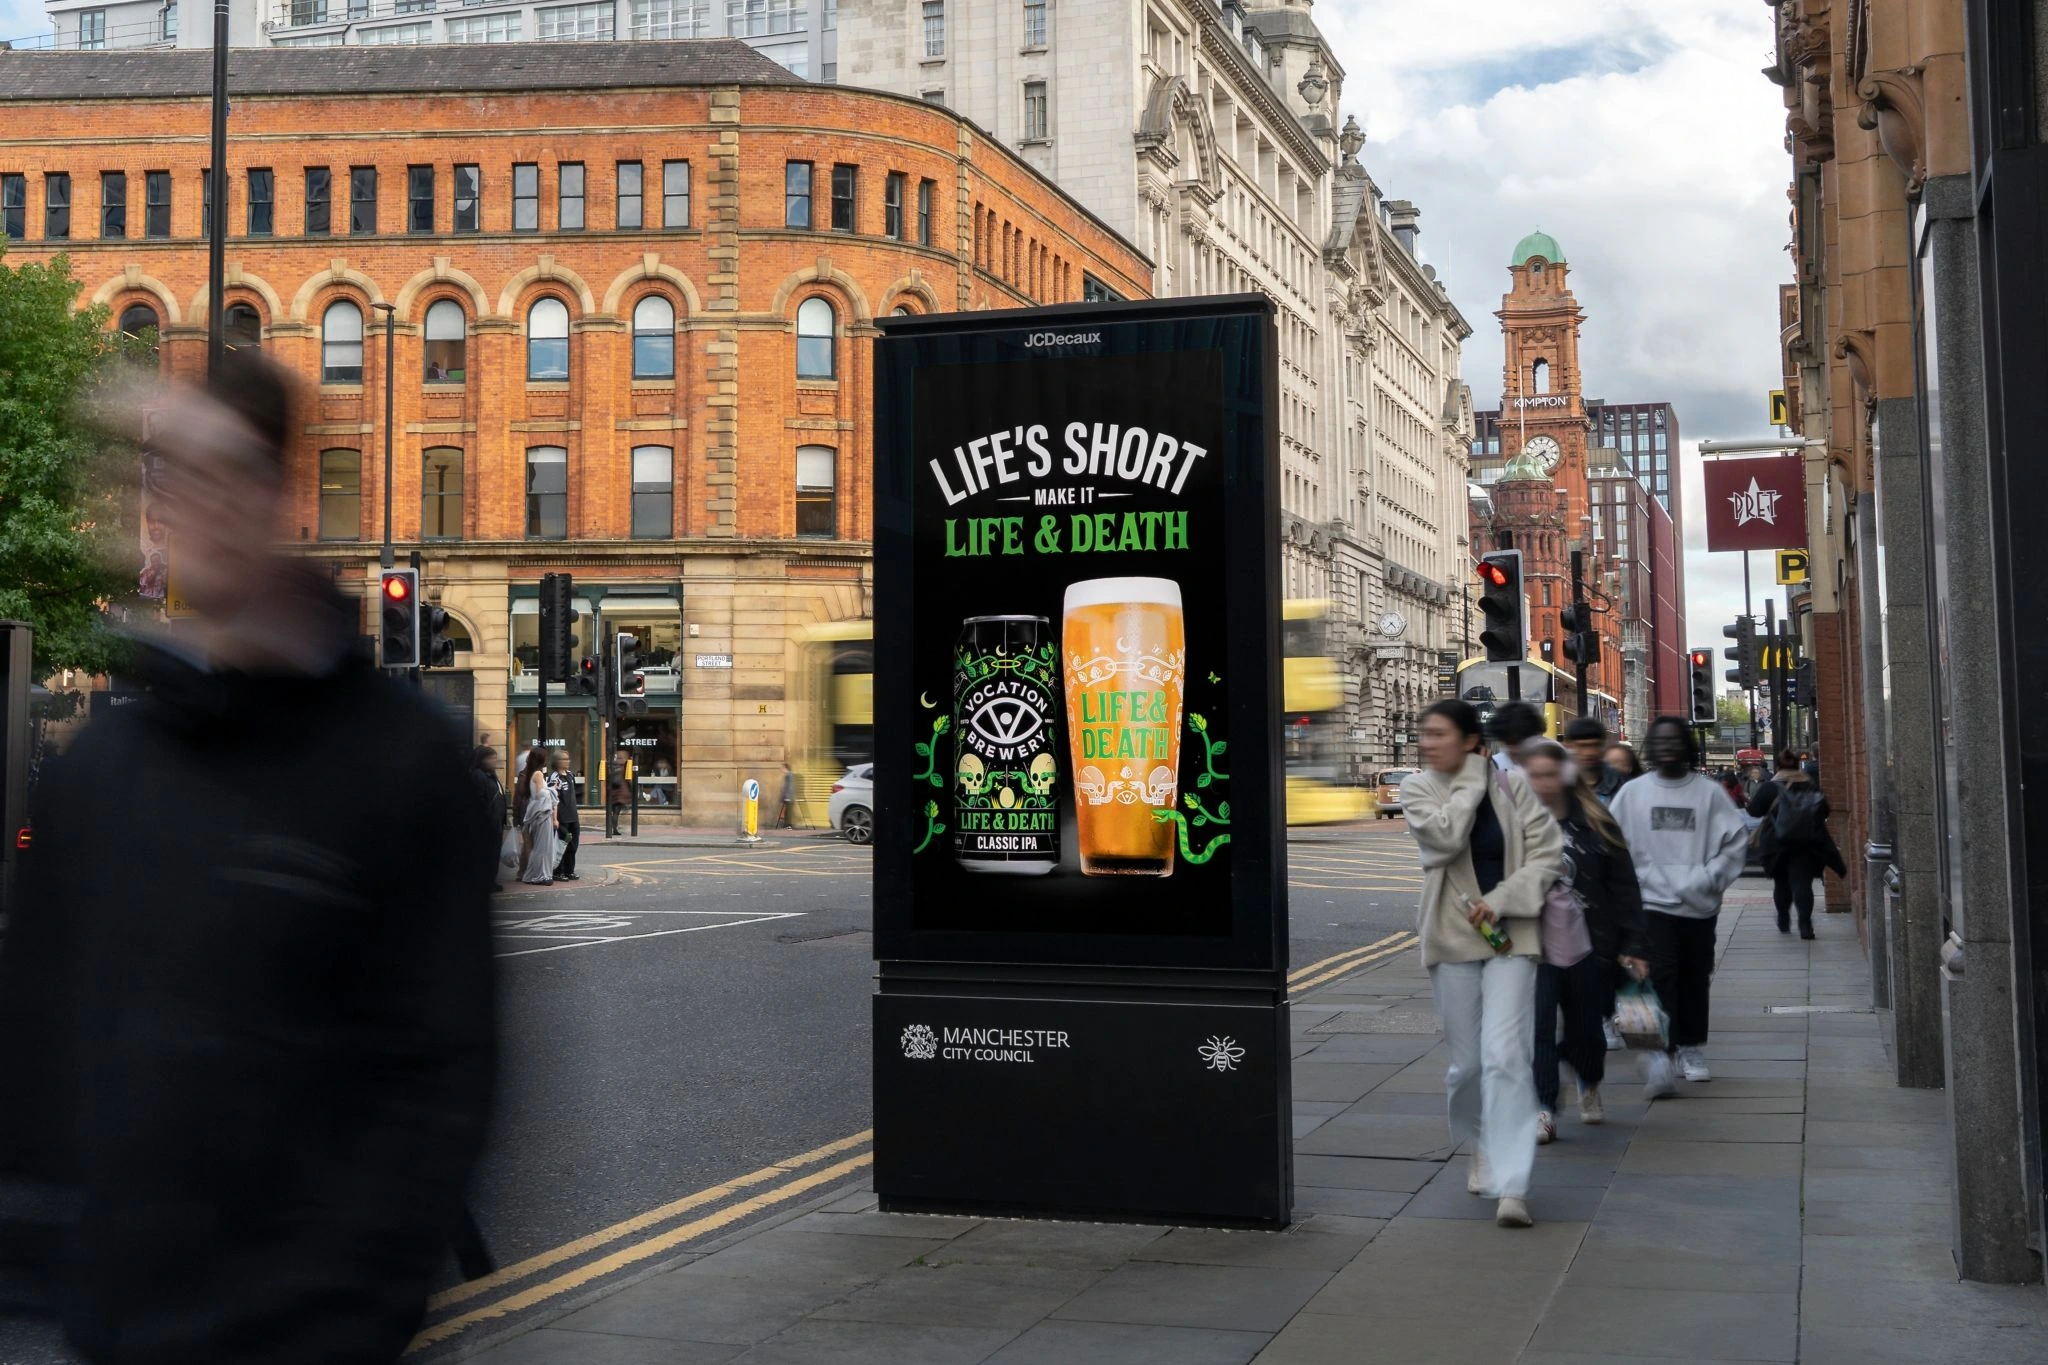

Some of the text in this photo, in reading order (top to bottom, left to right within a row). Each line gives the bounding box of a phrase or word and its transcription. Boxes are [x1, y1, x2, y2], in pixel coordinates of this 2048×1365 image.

[1024, 332, 1101, 348] JCDecaux
[1514, 396, 1566, 408] KIMPTON
[929, 421, 1207, 506] LIFE'S SHORT
[1034, 486, 1095, 506] MAKE IT
[1733, 490, 1777, 519] PRET
[944, 510, 1189, 557] LIFE & DEATH
[965, 681, 1049, 713] VOCATION
[532, 738, 658, 746] BANK STREET
[966, 729, 1046, 760] BREWERY
[1081, 727, 1169, 760] DEATH
[961, 812, 1055, 831] LIFE & DEATH
[977, 835, 1019, 850] CLASSIC
[1021, 836, 1038, 850] IPA
[943, 1027, 1071, 1048] MANCHESTER
[942, 1047, 1034, 1062] CITY COUNCIL
